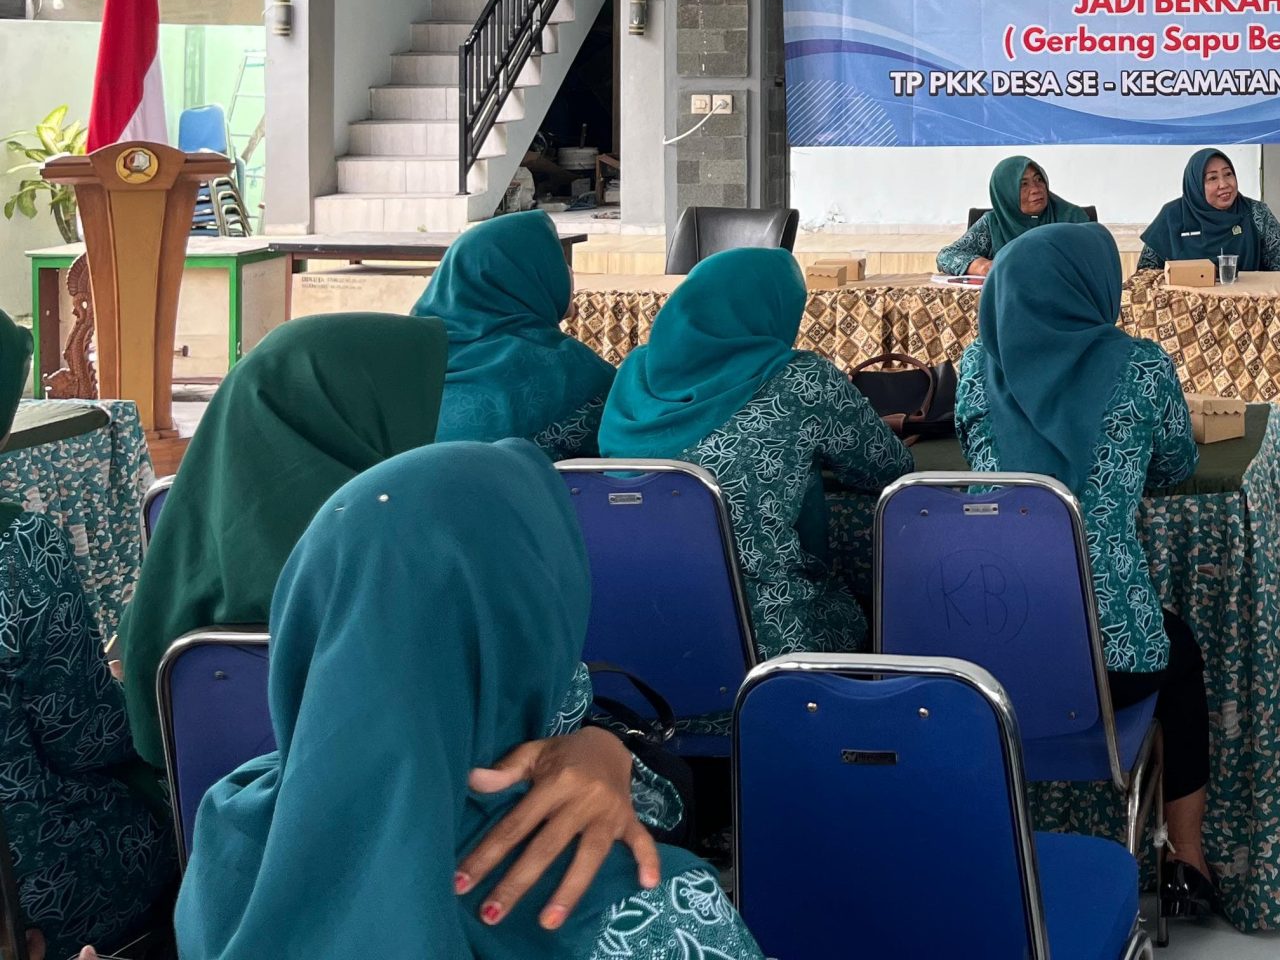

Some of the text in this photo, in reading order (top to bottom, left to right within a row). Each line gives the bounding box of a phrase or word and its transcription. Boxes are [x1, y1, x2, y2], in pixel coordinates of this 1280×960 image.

[1022, 25, 1155, 58] Gerbang
[1163, 25, 1240, 58] Sapu
[889, 70, 924, 95] TP
[929, 70, 988, 95] PKK
[992, 69, 1062, 95] DESA
[1067, 69, 1100, 95] SE
[939, 558, 1008, 635] KB
